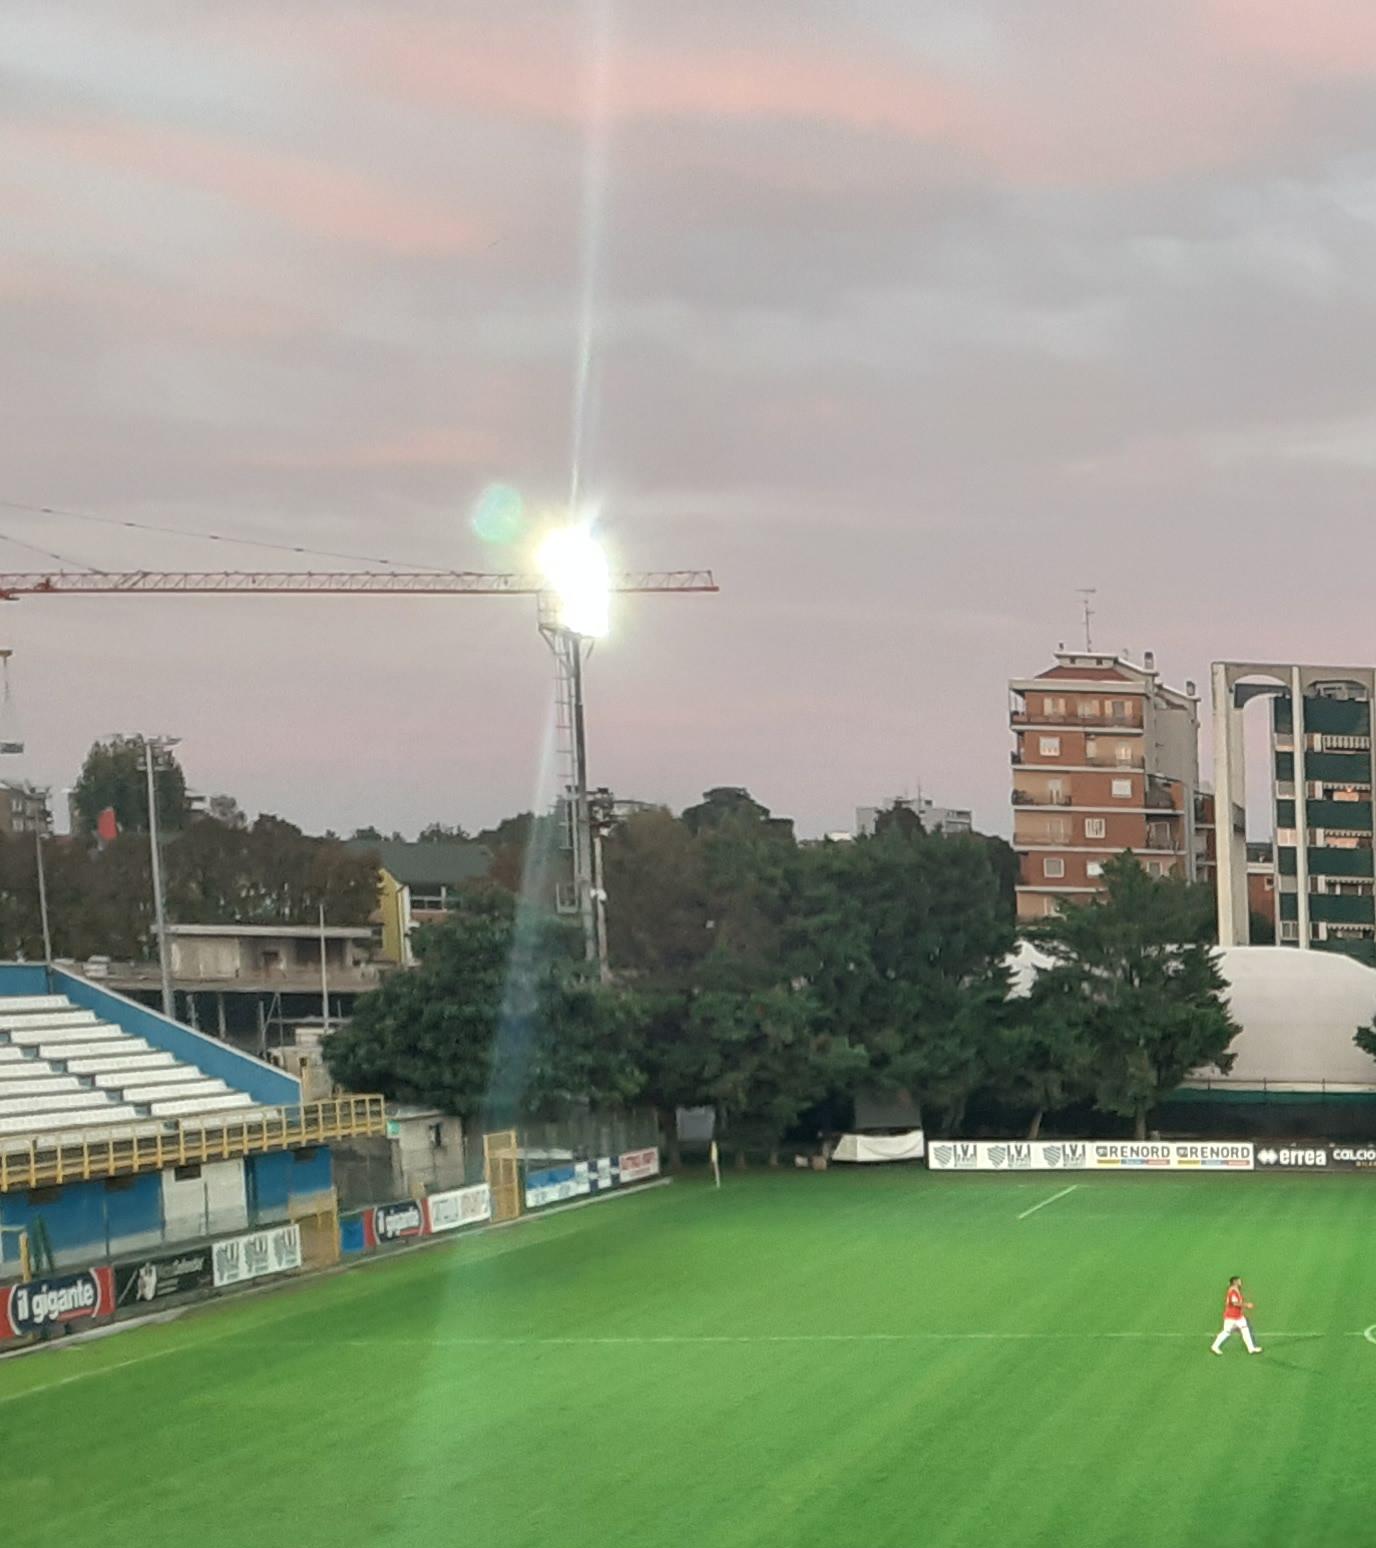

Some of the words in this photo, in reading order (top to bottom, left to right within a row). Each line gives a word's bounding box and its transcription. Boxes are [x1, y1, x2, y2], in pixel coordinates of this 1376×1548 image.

[1109, 1145, 1171, 1158] RENORD
[1190, 1146, 1250, 1159] RENORD
[17, 1289, 29, 1321] il
[32, 1279, 95, 1324] gigante
